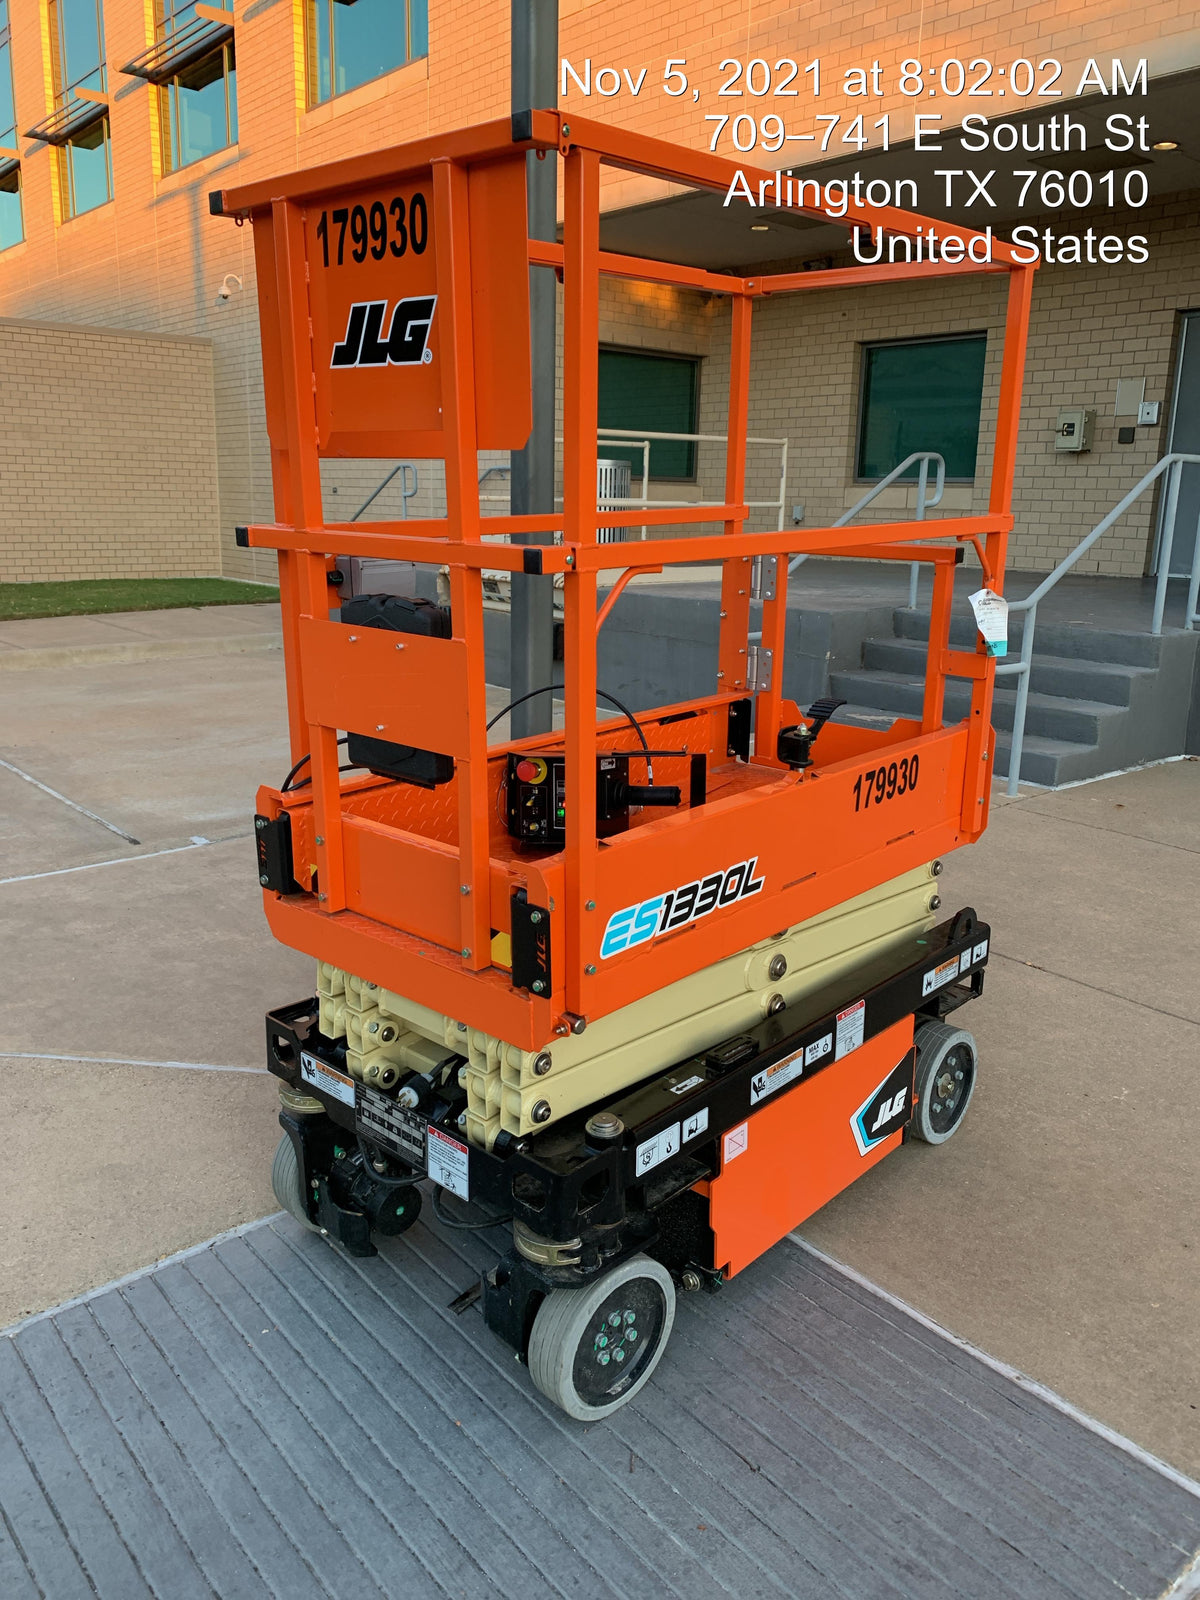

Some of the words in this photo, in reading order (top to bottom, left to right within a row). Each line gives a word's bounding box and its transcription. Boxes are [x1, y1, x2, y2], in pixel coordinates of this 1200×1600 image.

[316, 192, 429, 268] 179930
[330, 295, 438, 369] JLG
[853, 753, 920, 813] 179930
[600, 856, 766, 960] ES1330L
[871, 1086, 908, 1133] JLG
